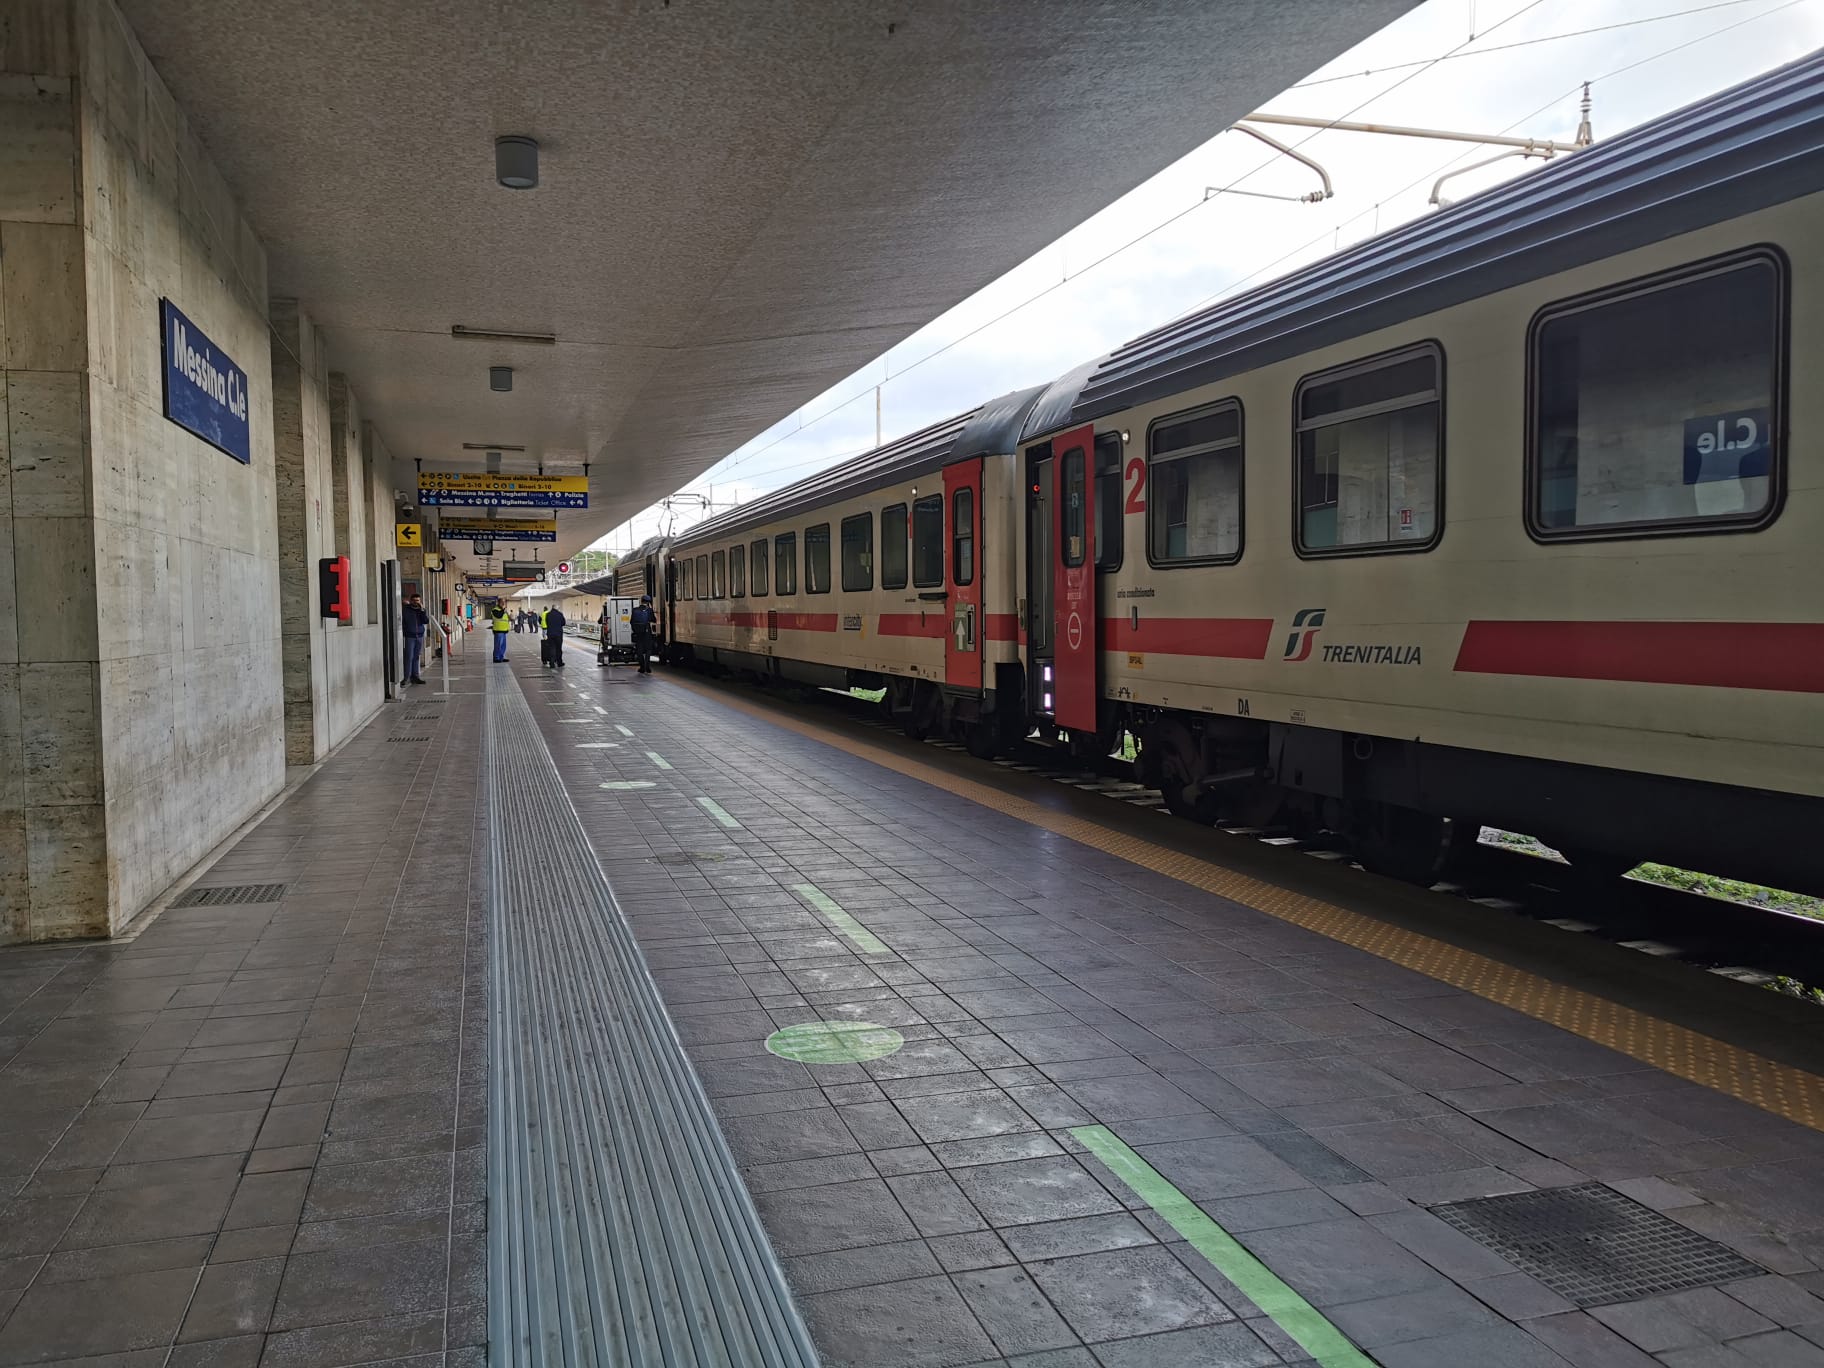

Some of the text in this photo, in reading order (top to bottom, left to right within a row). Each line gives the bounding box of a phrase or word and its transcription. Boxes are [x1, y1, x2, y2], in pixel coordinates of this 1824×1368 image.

[173, 317, 246, 422] Messina C.le
[1125, 457, 1146, 514] 2
[1322, 645, 1422, 665] TRENITALIA
[1238, 698, 1250, 716] DA
